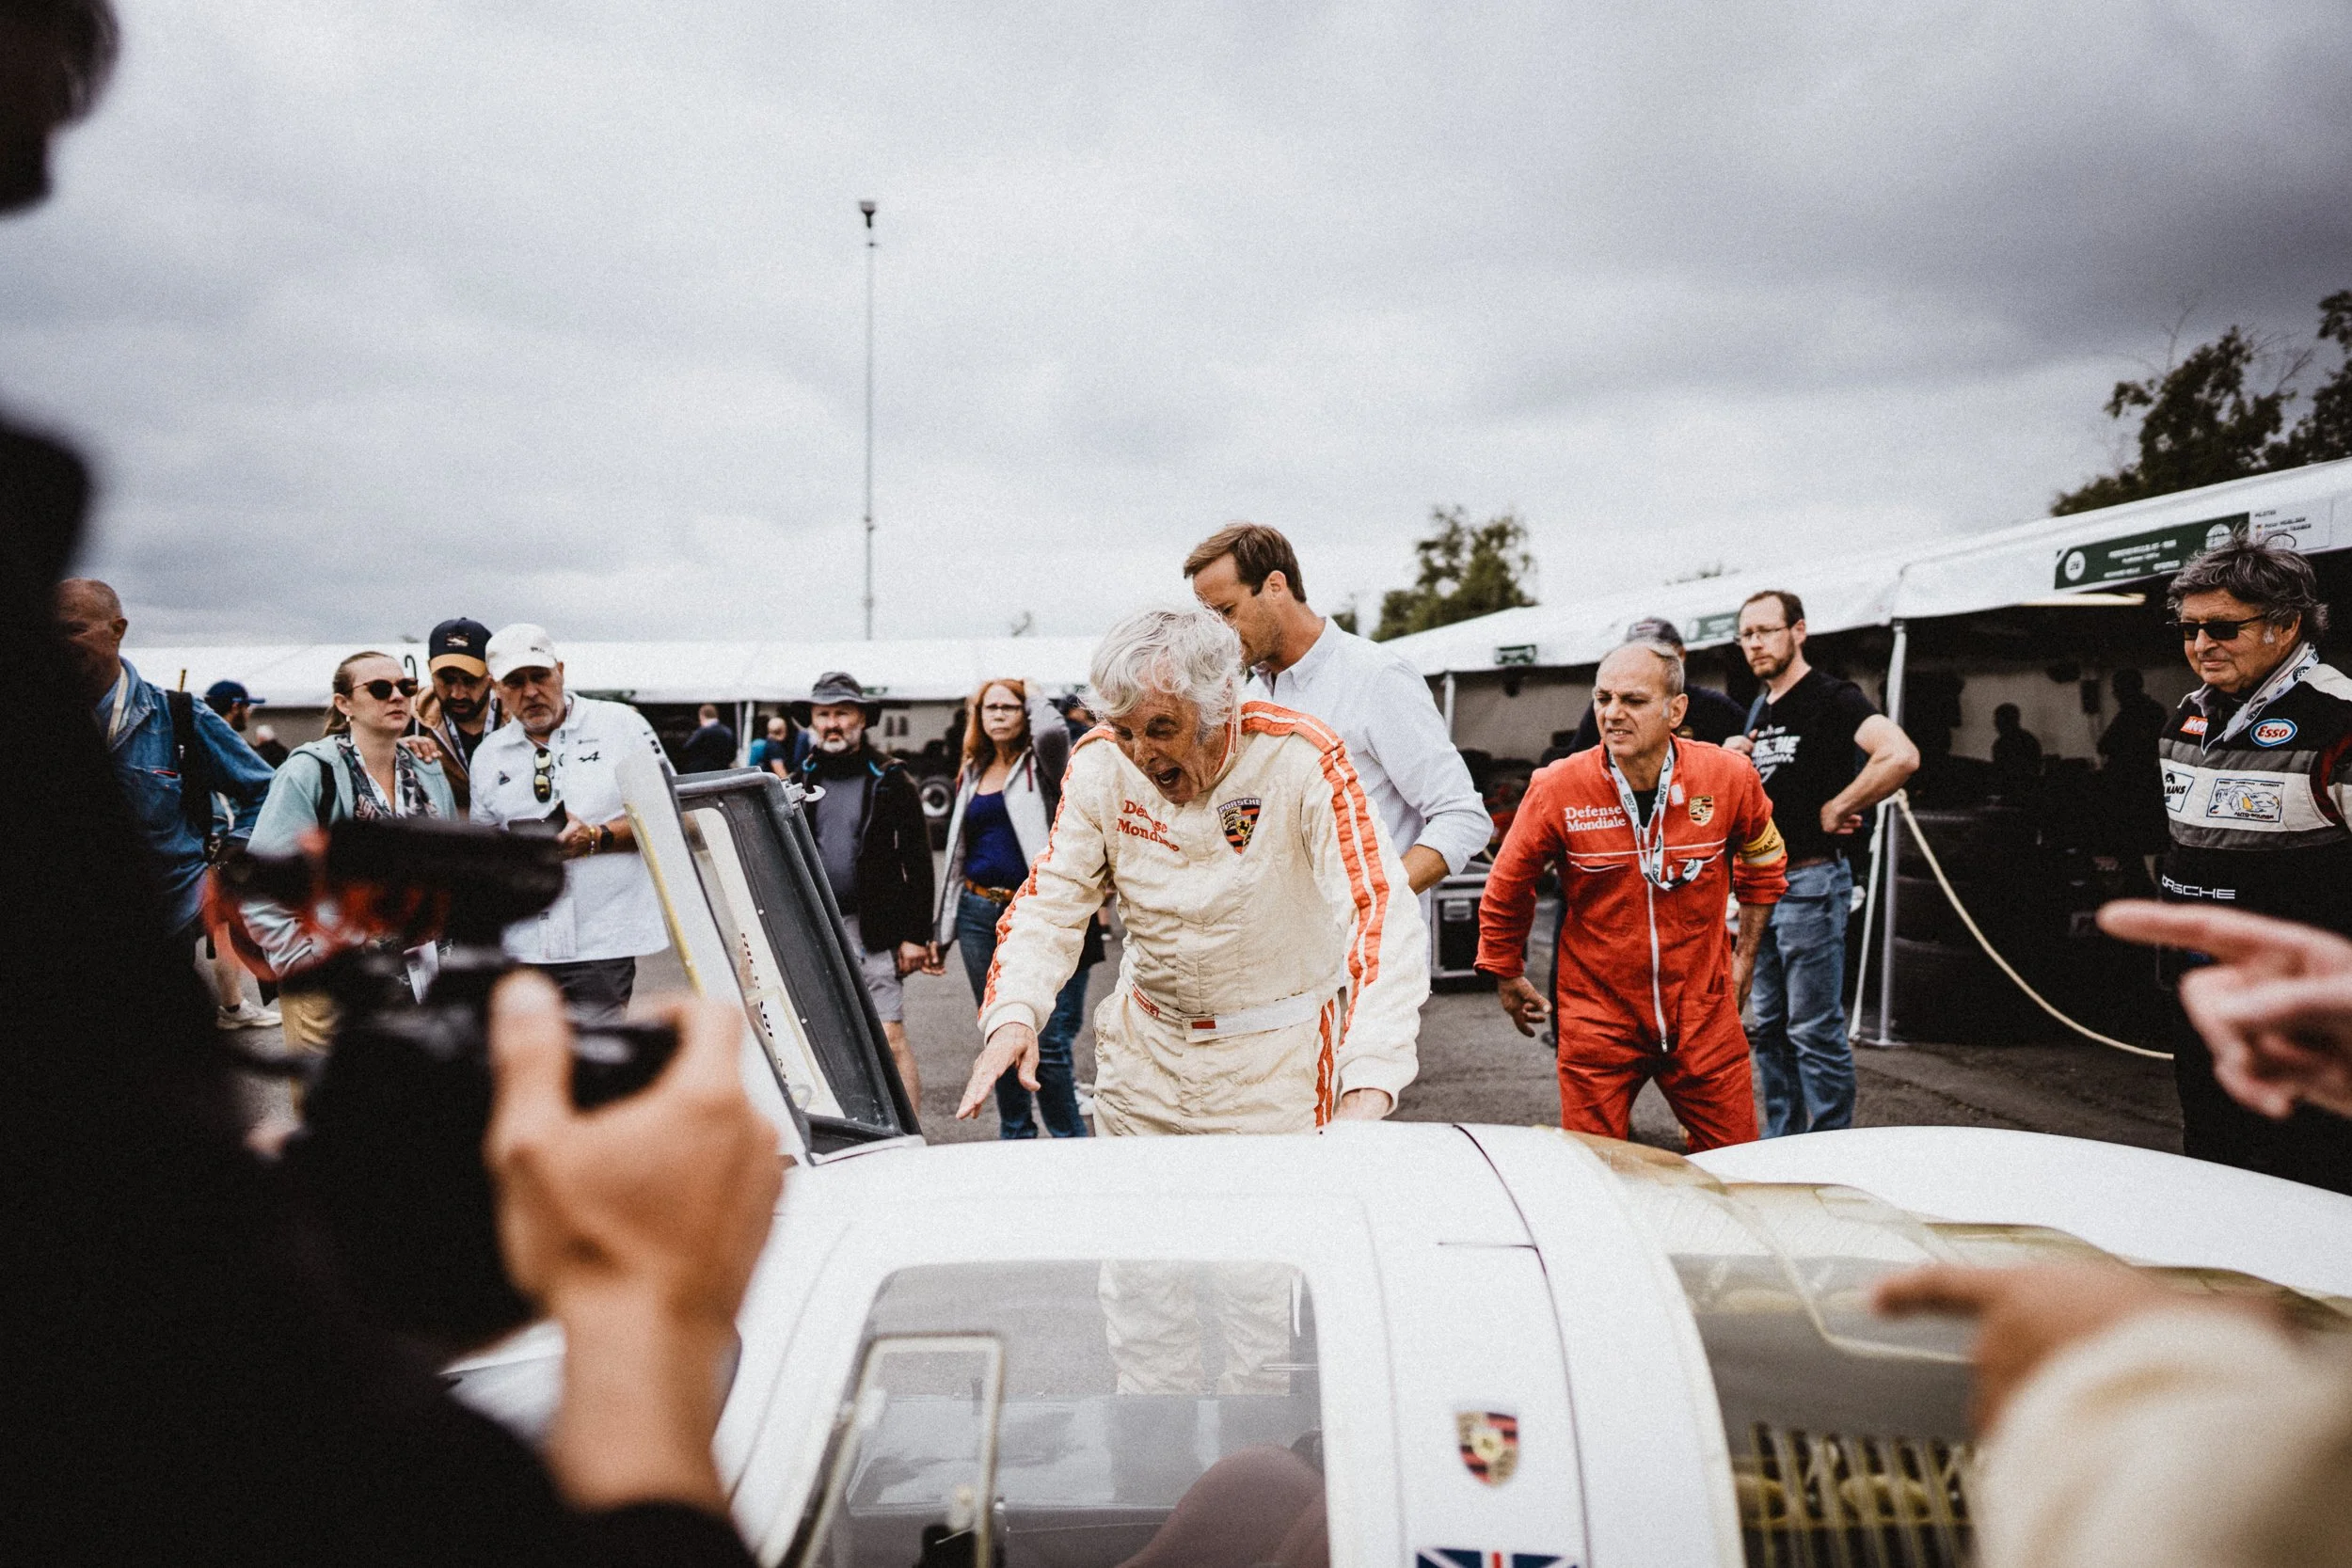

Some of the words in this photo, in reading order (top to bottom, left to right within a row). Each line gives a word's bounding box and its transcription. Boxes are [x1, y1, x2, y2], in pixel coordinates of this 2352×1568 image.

[2258, 725, 2288, 738] Esso
[1218, 799, 1261, 814] PORSCHE
[1565, 805, 1623, 820] Defense
[1565, 816, 1627, 832] Mondiale
[2162, 874, 2236, 899] ORSCHE
